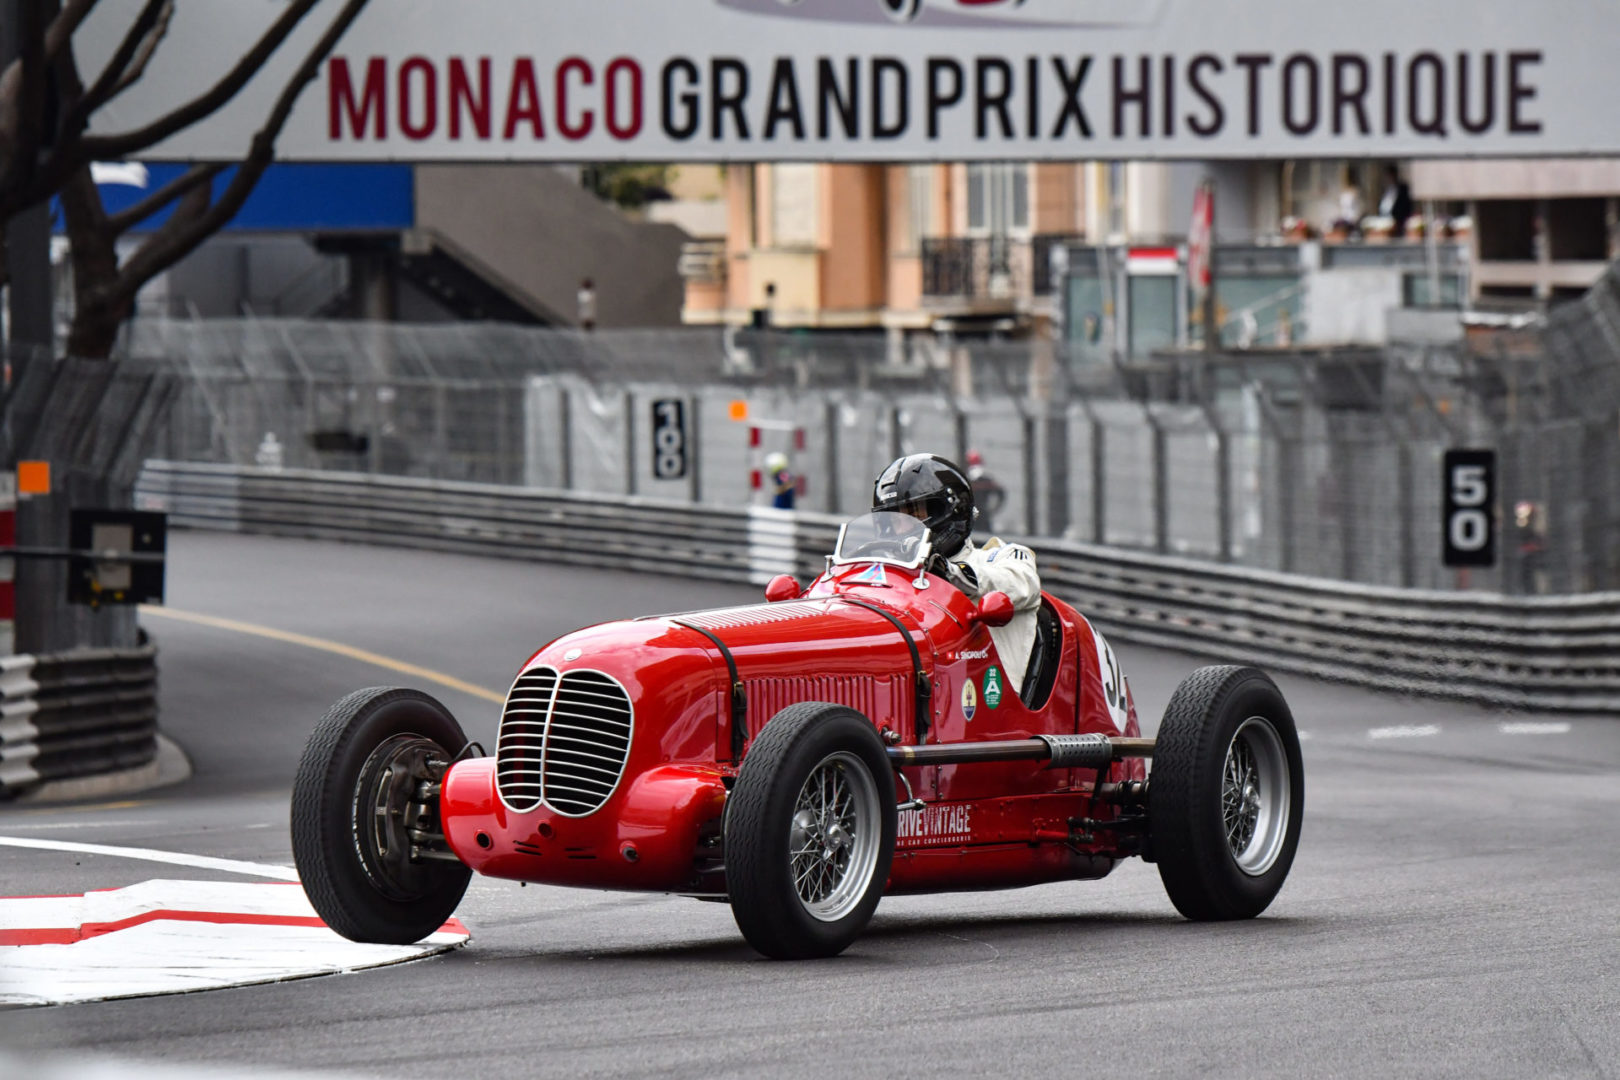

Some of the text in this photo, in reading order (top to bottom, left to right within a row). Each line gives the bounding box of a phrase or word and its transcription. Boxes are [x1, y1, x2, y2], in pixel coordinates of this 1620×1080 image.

[327, 50, 1544, 141] MONACO GRAND PRIX HISTORIQUE
[657, 403, 682, 475] 100
[1450, 464, 1489, 552] 50
[985, 681, 1000, 694] A
[897, 805, 971, 837] RIVEVINTAGE
